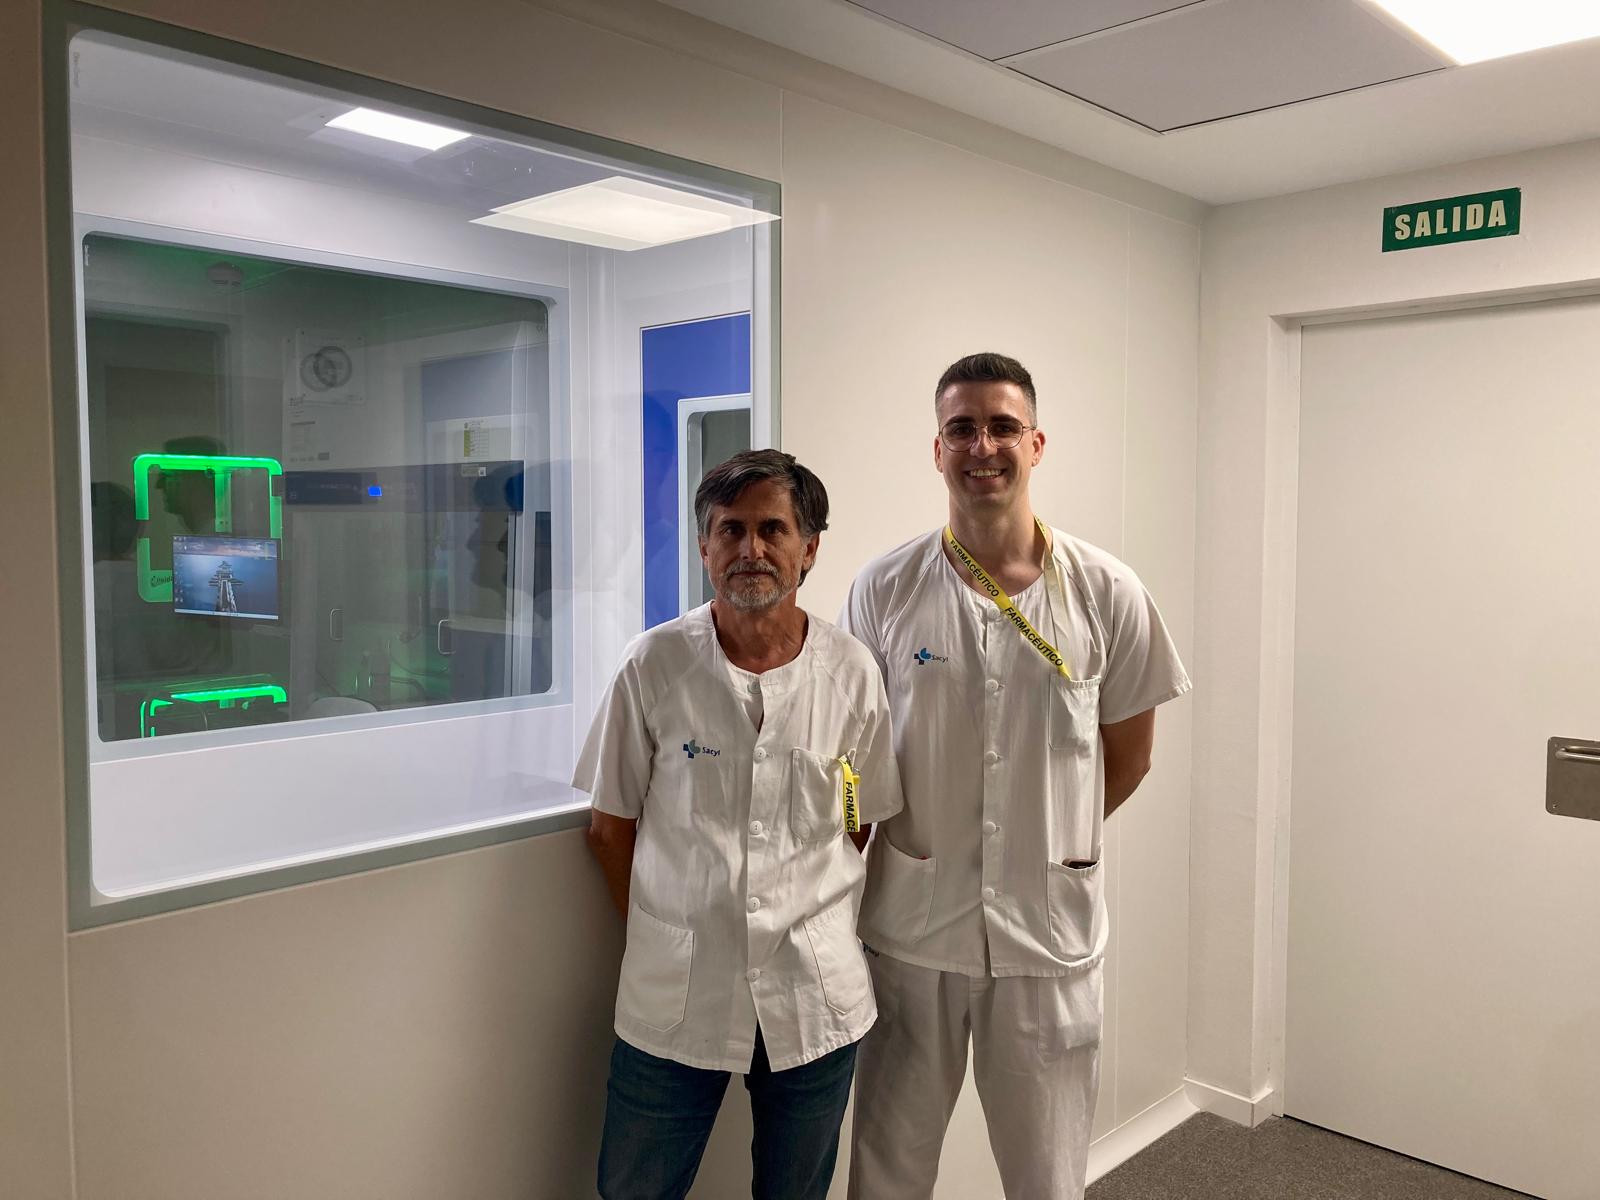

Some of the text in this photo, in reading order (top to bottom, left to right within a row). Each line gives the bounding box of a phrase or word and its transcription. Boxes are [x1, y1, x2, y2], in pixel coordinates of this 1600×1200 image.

[1394, 200, 1507, 240] SALIDA
[950, 539, 1000, 598] FARMACÉUTICO
[931, 654, 949, 663] Sacyl
[702, 746, 721, 757] Sacyl
